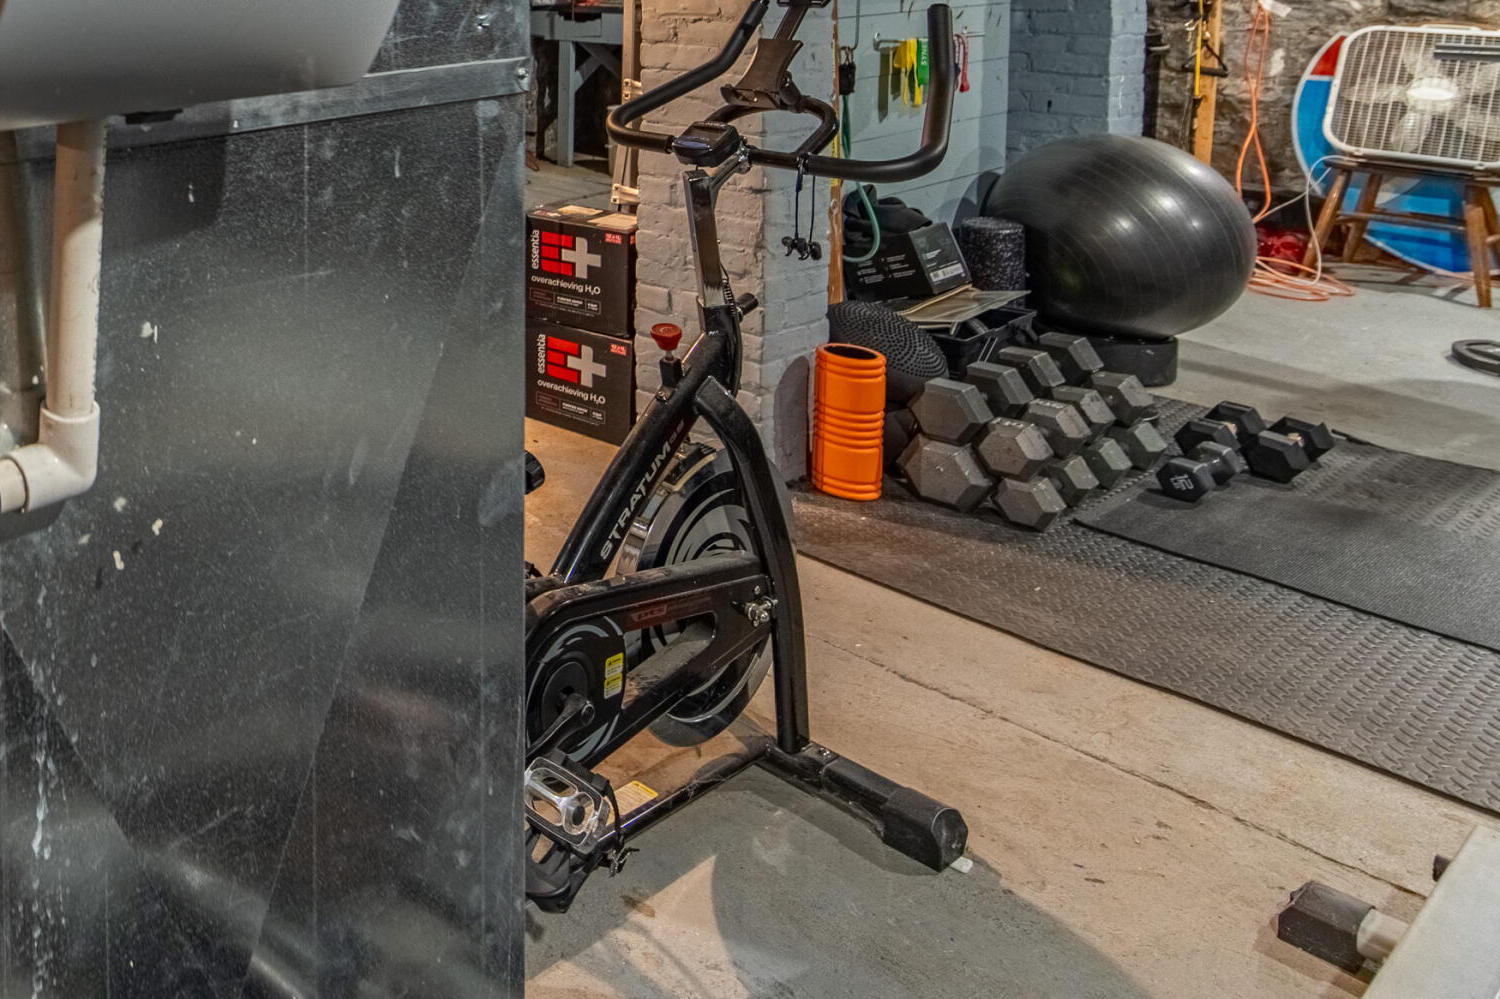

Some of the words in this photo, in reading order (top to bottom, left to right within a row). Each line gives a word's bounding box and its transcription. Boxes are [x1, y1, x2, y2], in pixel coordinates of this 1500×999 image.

[531, 229, 540, 270] essentia
[531, 275, 584, 293] overachieving
[537, 333, 546, 374] essentia
[537, 379, 589, 401] overachieving
[600, 440, 672, 560] STRATUM
